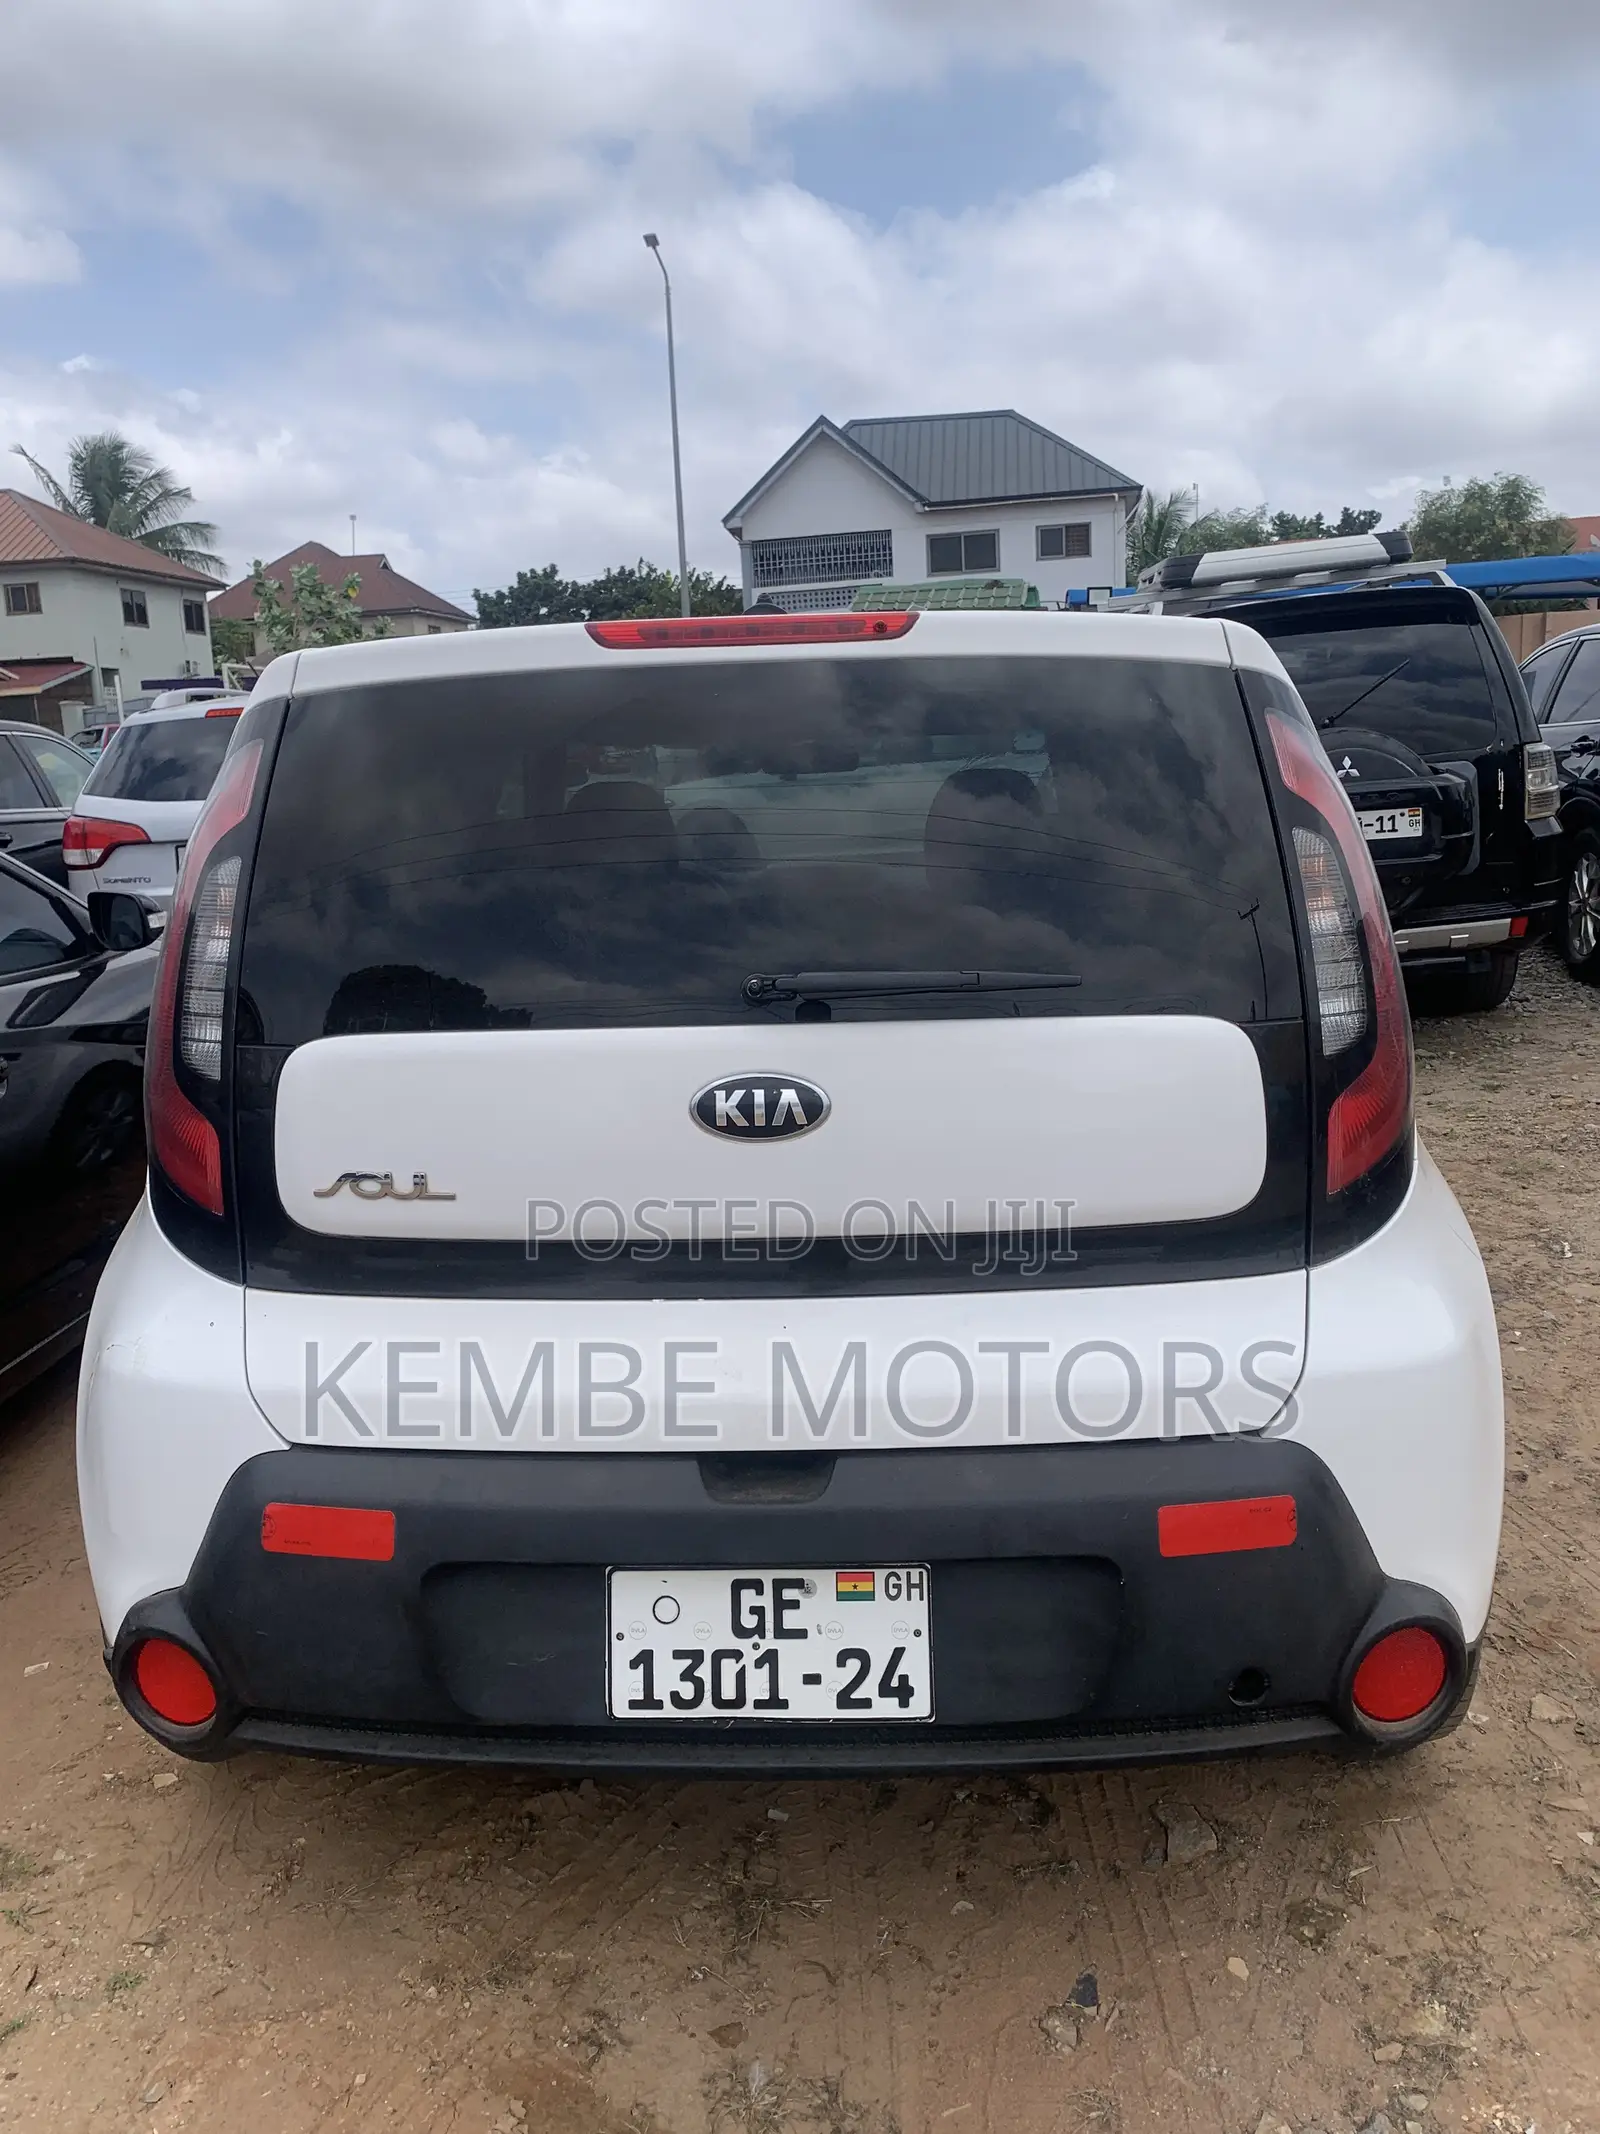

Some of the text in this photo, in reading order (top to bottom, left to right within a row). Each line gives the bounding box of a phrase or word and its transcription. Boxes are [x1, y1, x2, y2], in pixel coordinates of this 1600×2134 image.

[1408, 818, 1421, 828] GH
[713, 1088, 808, 1127] KIA
[884, 1570, 925, 1602] GH
[731, 1578, 807, 1639] GE
[628, 1647, 915, 1710] 1301-24
